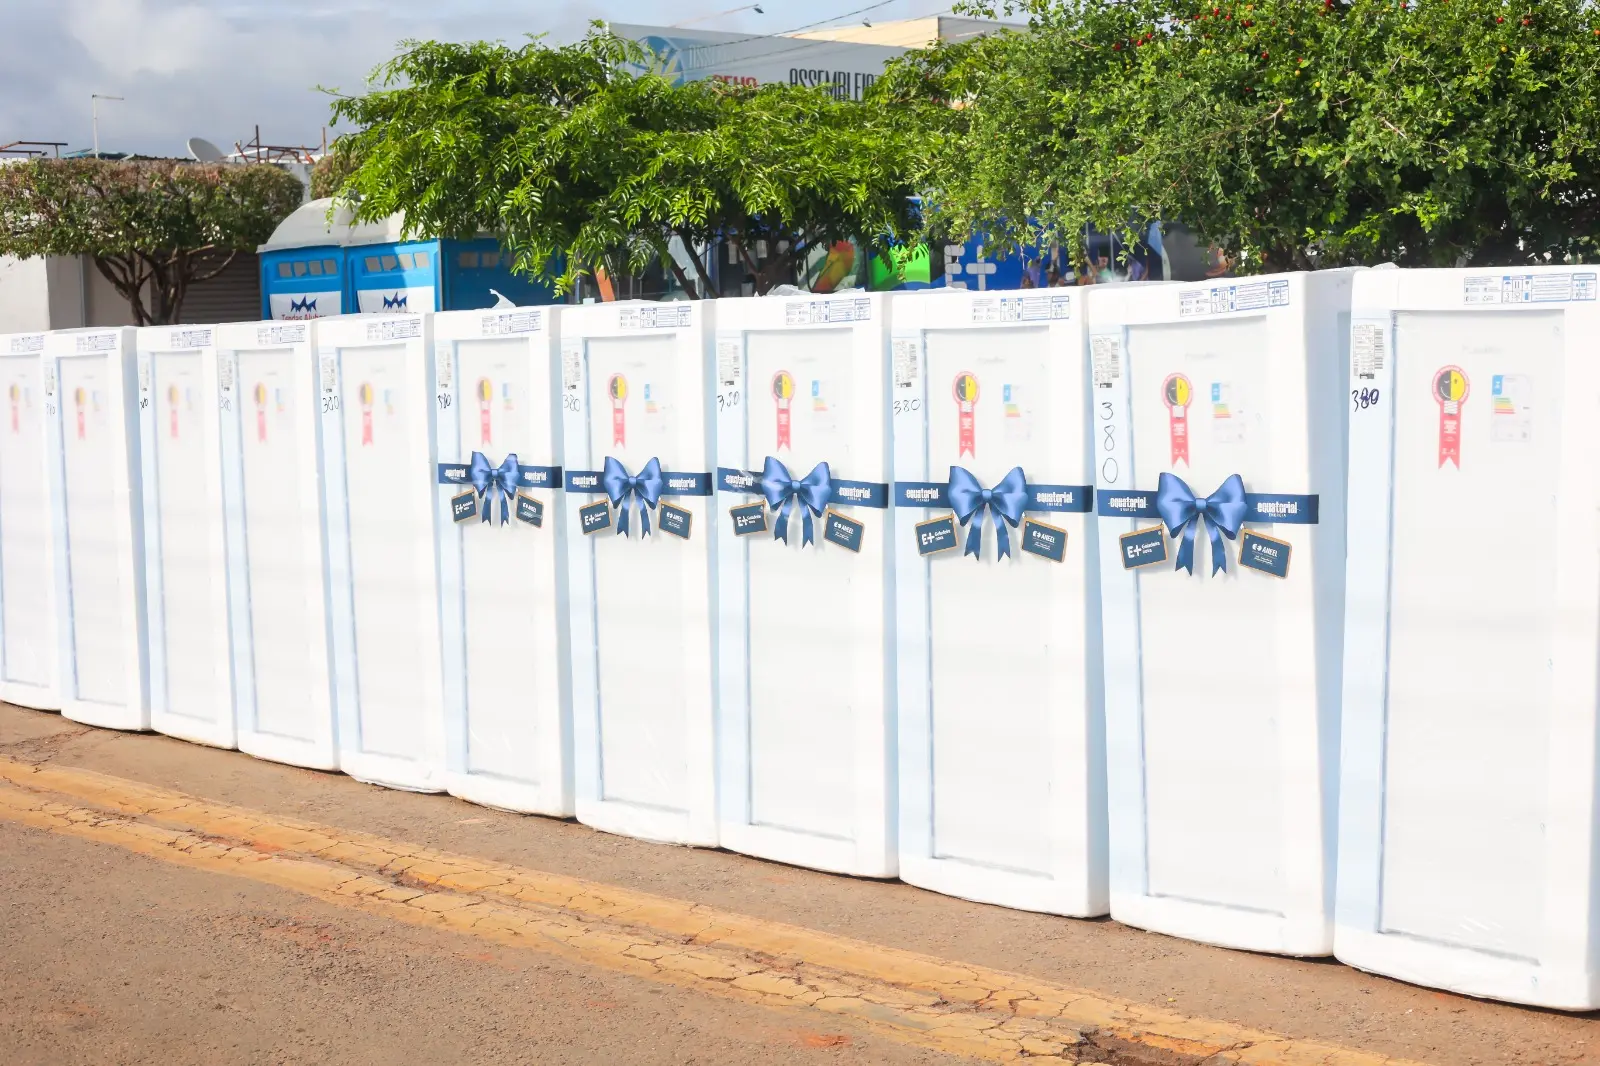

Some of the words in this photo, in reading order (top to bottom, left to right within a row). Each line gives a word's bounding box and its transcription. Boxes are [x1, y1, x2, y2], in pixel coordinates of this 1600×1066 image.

[1352, 387, 1380, 412] 380
[893, 398, 921, 415] 380
[839, 486, 871, 499] equatorial
[906, 487, 939, 500] equatorial
[1036, 491, 1073, 504] equatorial
[1110, 496, 1147, 509] equatorial
[1257, 501, 1298, 514] equatorial
[736, 515, 749, 527] E+
[921, 532, 935, 546] E+
[1127, 545, 1142, 559] E+
